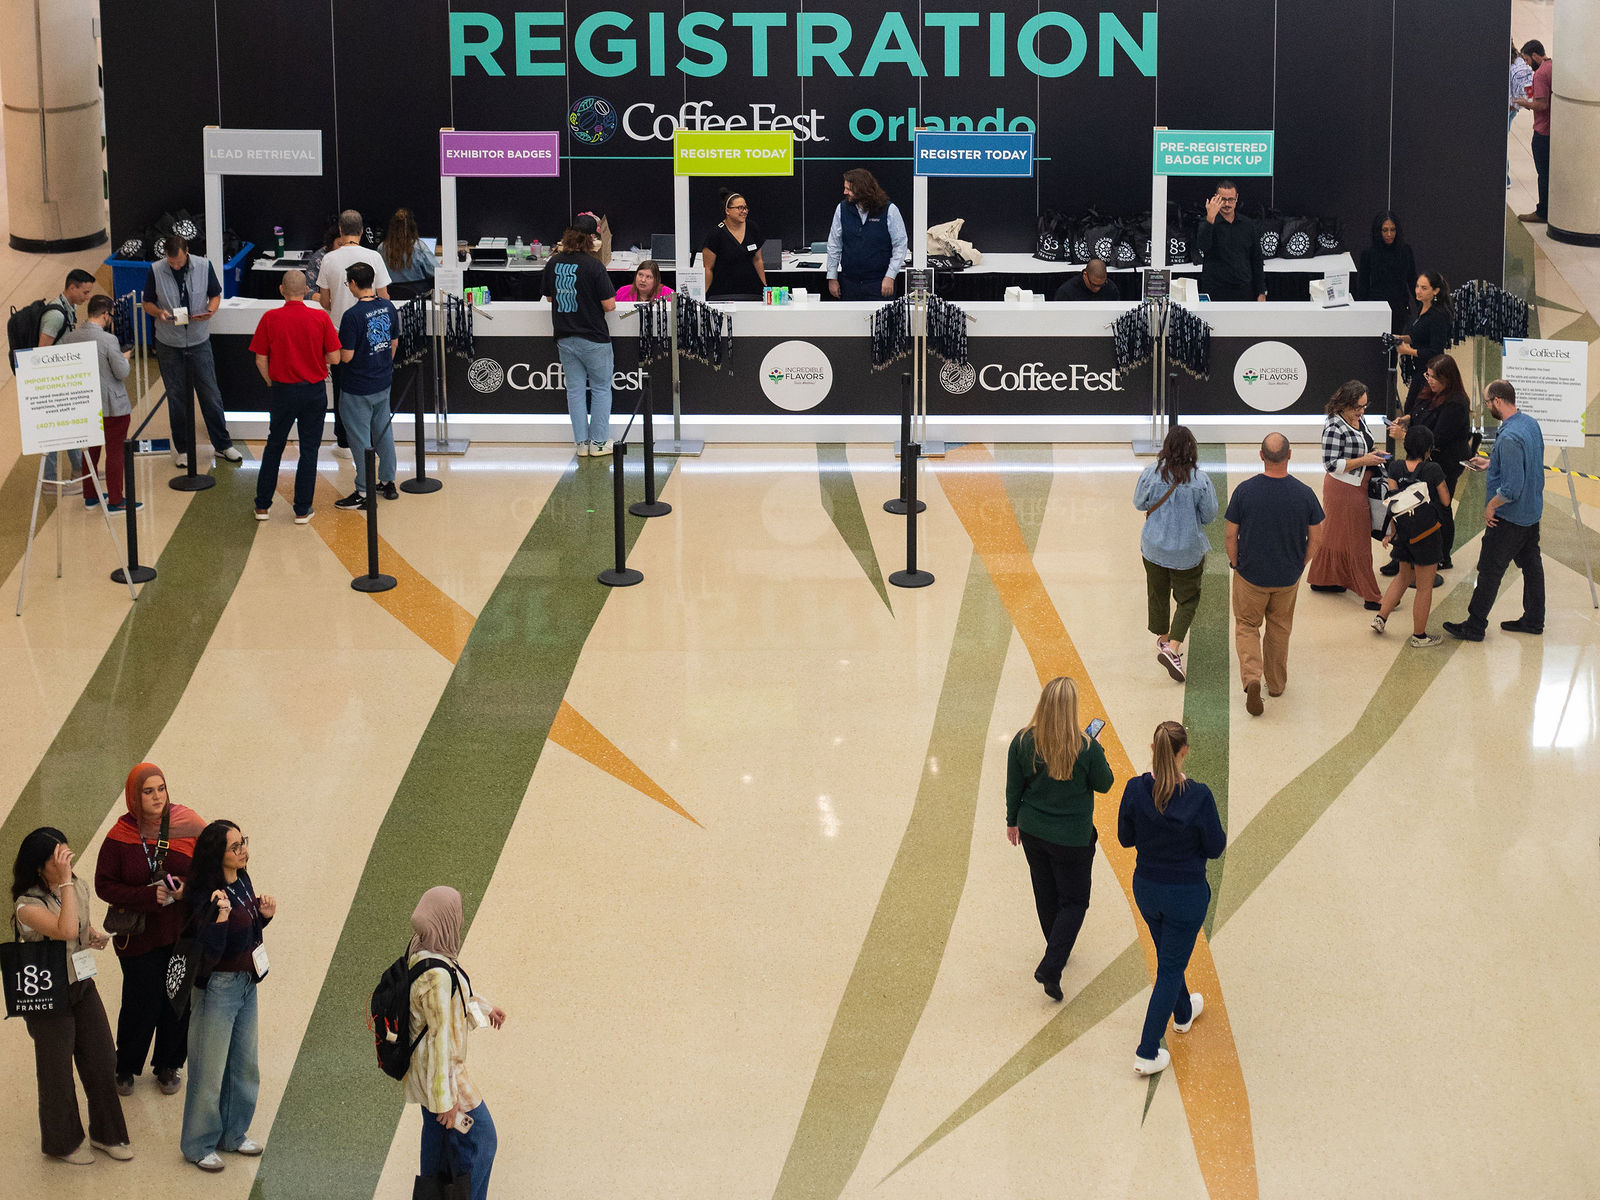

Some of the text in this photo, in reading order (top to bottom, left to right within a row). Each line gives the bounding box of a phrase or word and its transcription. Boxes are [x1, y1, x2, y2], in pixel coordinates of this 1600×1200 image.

[449, 11, 1158, 78] REGISTRATION
[849, 108, 1036, 142] Orlando
[1160, 142, 1268, 153] PRE-REGISTERED
[210, 148, 316, 161] LEAD RETRIEVAL
[446, 149, 552, 159] EXHIBITOR BADGES
[680, 149, 787, 159] REGISTER TODAY
[920, 149, 1028, 160] REGISTER TODAY
[1165, 155, 1263, 165] BADGE PICK UP
[16, 1003, 54, 1012] FRANCE
